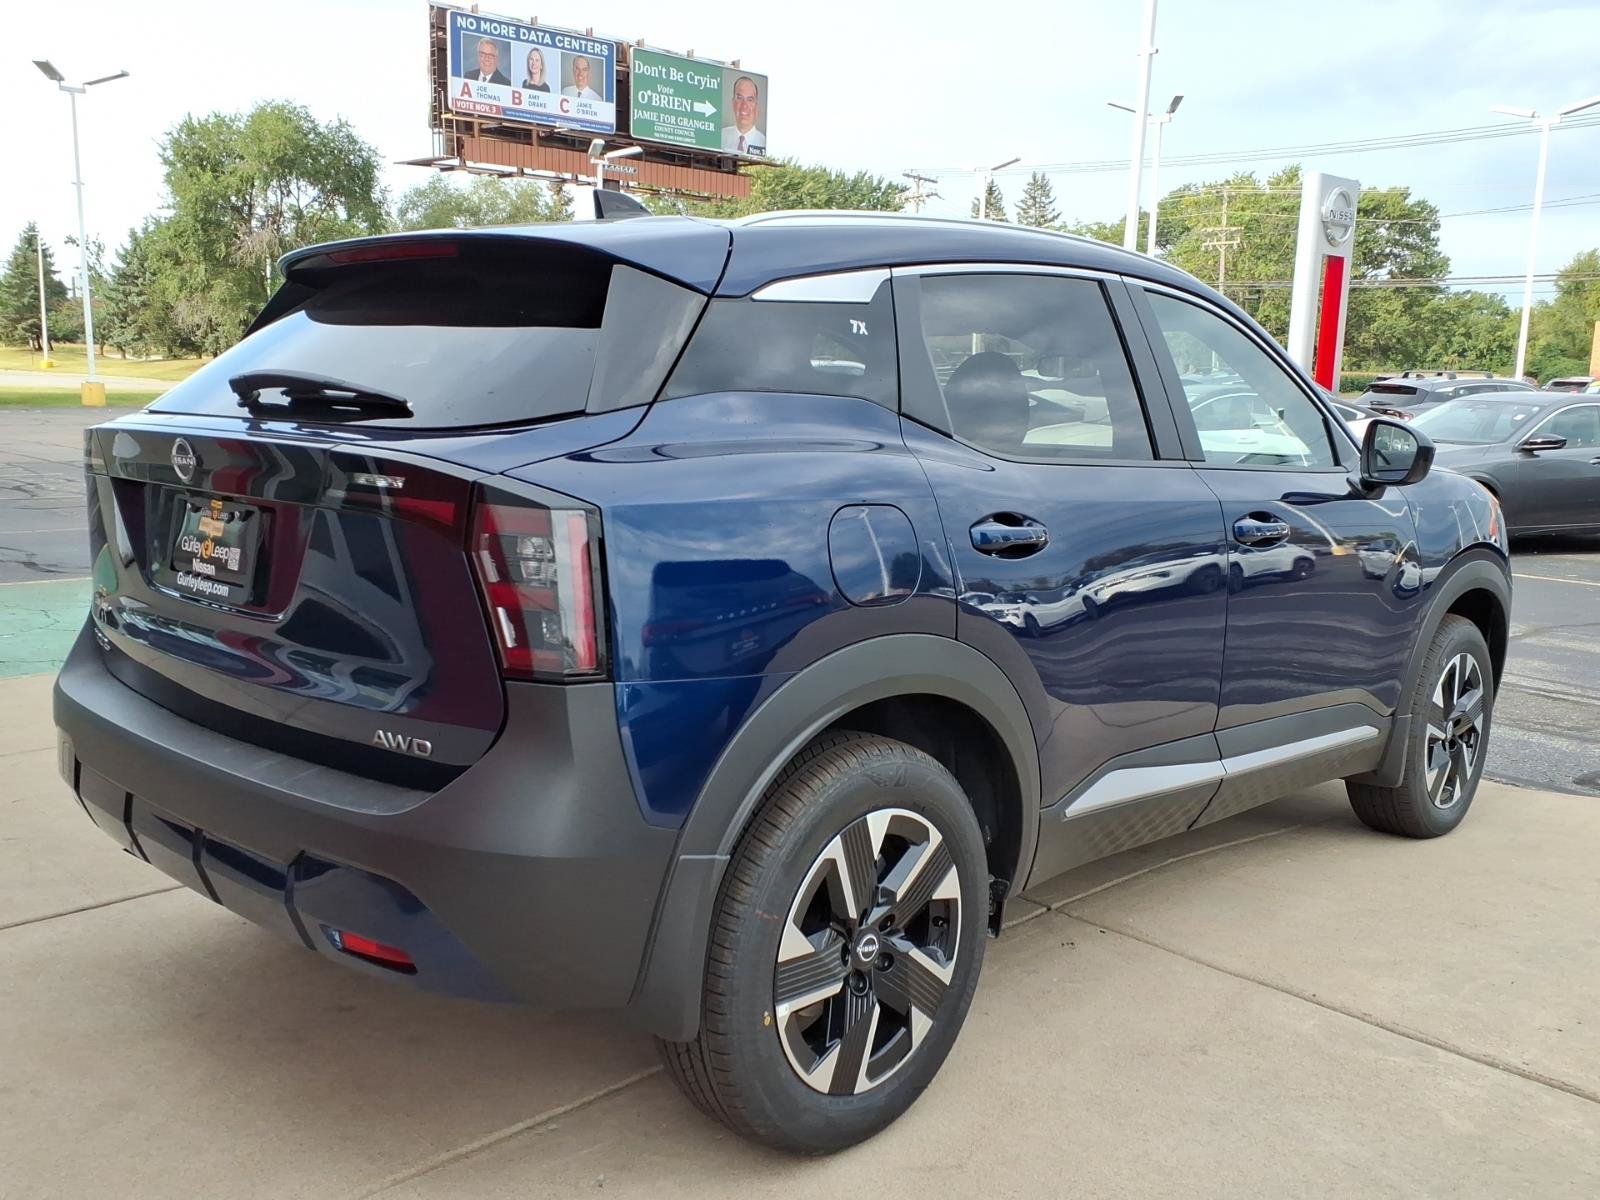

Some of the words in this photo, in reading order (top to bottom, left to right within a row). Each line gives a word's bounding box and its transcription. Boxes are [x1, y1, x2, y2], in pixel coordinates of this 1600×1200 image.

[457, 16, 477, 30] NO
[480, 20, 517, 39] MORE
[519, 28, 552, 45] DATA
[555, 36, 609, 56] CENTERS
[634, 60, 667, 79] Don't
[669, 67, 684, 82] Be
[687, 71, 721, 90] Cryin'
[460, 82, 472, 98] A
[476, 92, 501, 102] THOMAS
[528, 93, 540, 102] AMY
[657, 84, 675, 95] Vote
[511, 90, 523, 106] B
[528, 100, 547, 110] DRAKE
[560, 98, 570, 114] C
[638, 89, 691, 112] O'BRIEN
[456, 100, 474, 111] VOTE
[475, 103, 491, 113] NOV.
[492, 105, 497, 114] 3
[634, 109, 659, 122] JAMIE
[660, 113, 676, 125] FOR
[677, 116, 715, 132] GRANGER
[654, 125, 674, 135] COUNTY
[181, 536, 203, 558] Gurley
[211, 542, 229, 563] Leep
[192, 558, 216, 576] Nissan
[373, 729, 432, 756] AWD
